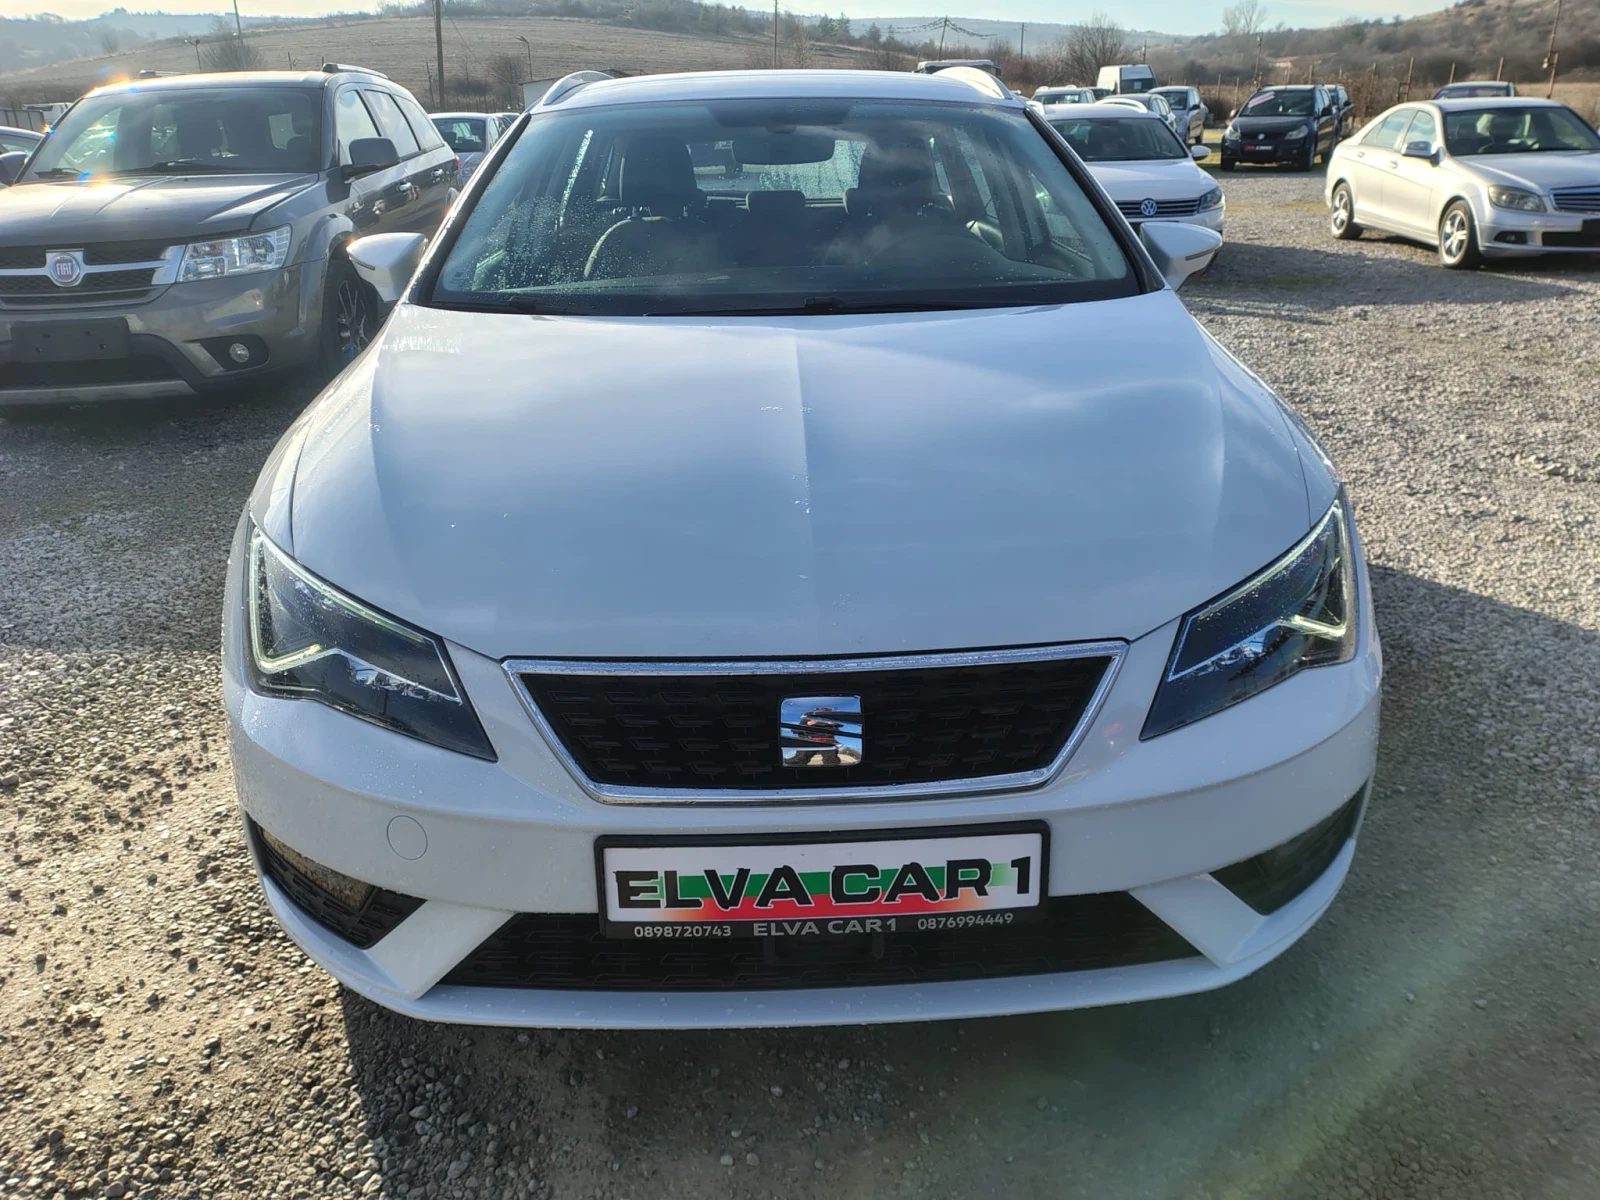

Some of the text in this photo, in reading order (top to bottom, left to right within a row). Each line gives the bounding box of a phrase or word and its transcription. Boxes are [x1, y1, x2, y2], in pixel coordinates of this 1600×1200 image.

[56, 262, 73, 276] FIAT
[613, 856, 1031, 911] ELVA CAR 1
[634, 925, 732, 938] 0898720743
[753, 920, 820, 937] ELVA
[917, 912, 1014, 930] 0876994449
